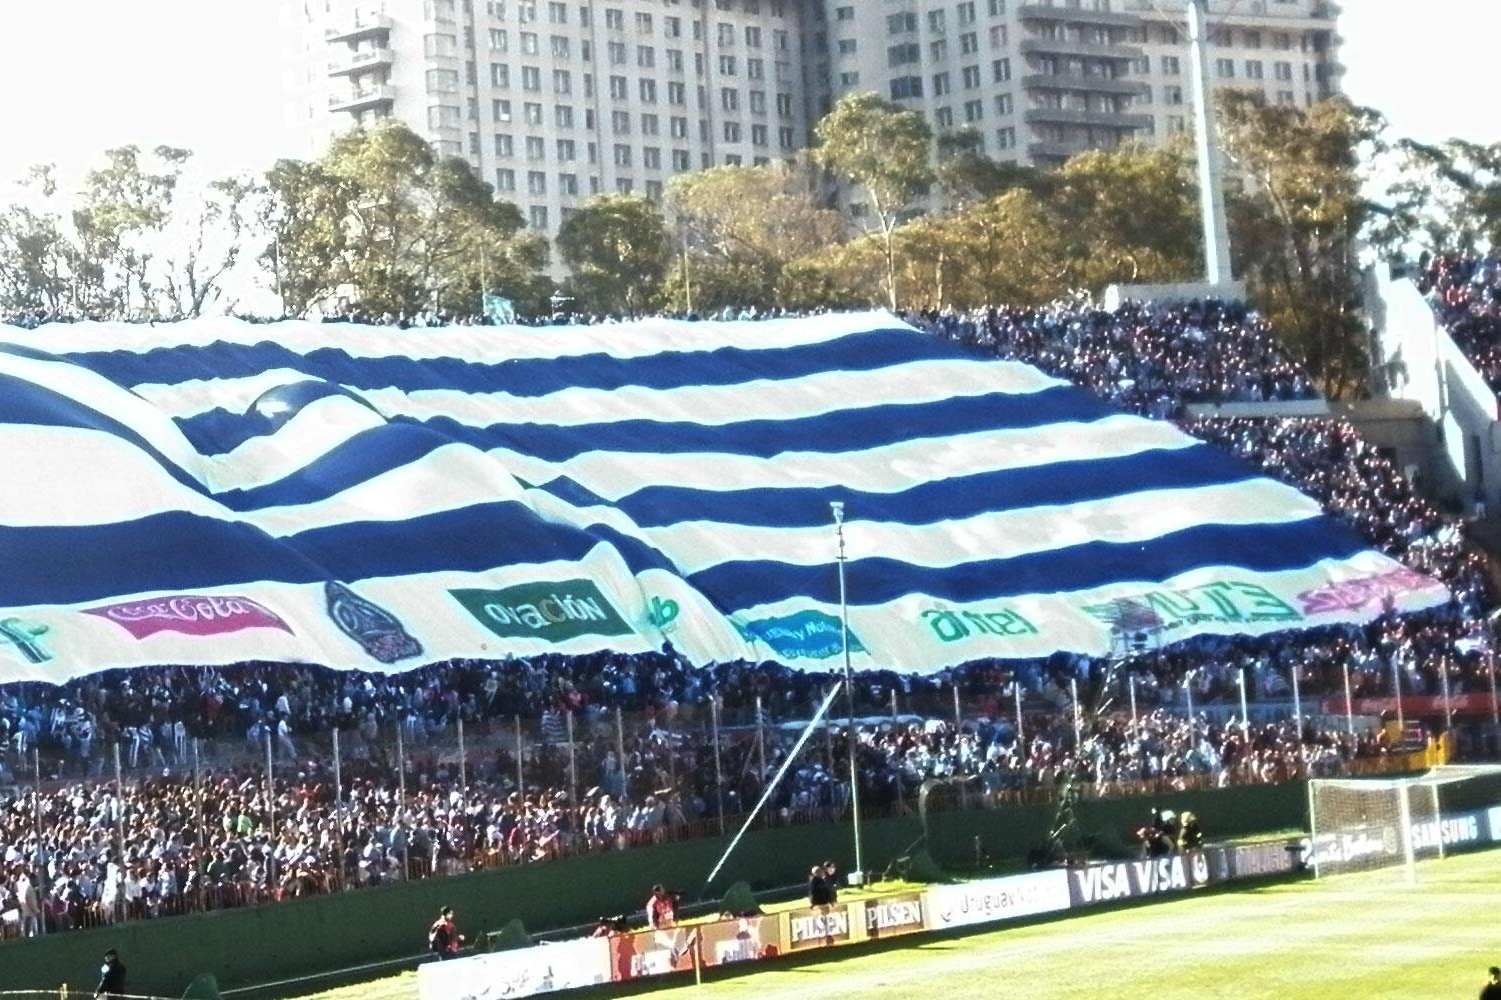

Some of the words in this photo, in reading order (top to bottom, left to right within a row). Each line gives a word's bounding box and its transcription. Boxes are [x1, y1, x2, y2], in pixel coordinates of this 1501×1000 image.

[1412, 815, 1478, 850] SAMSUNG
[1075, 865, 1132, 902] VISA
[1133, 856, 1187, 893] VISA
[791, 911, 849, 943] PILSEN
[866, 901, 921, 930] PILSEN
